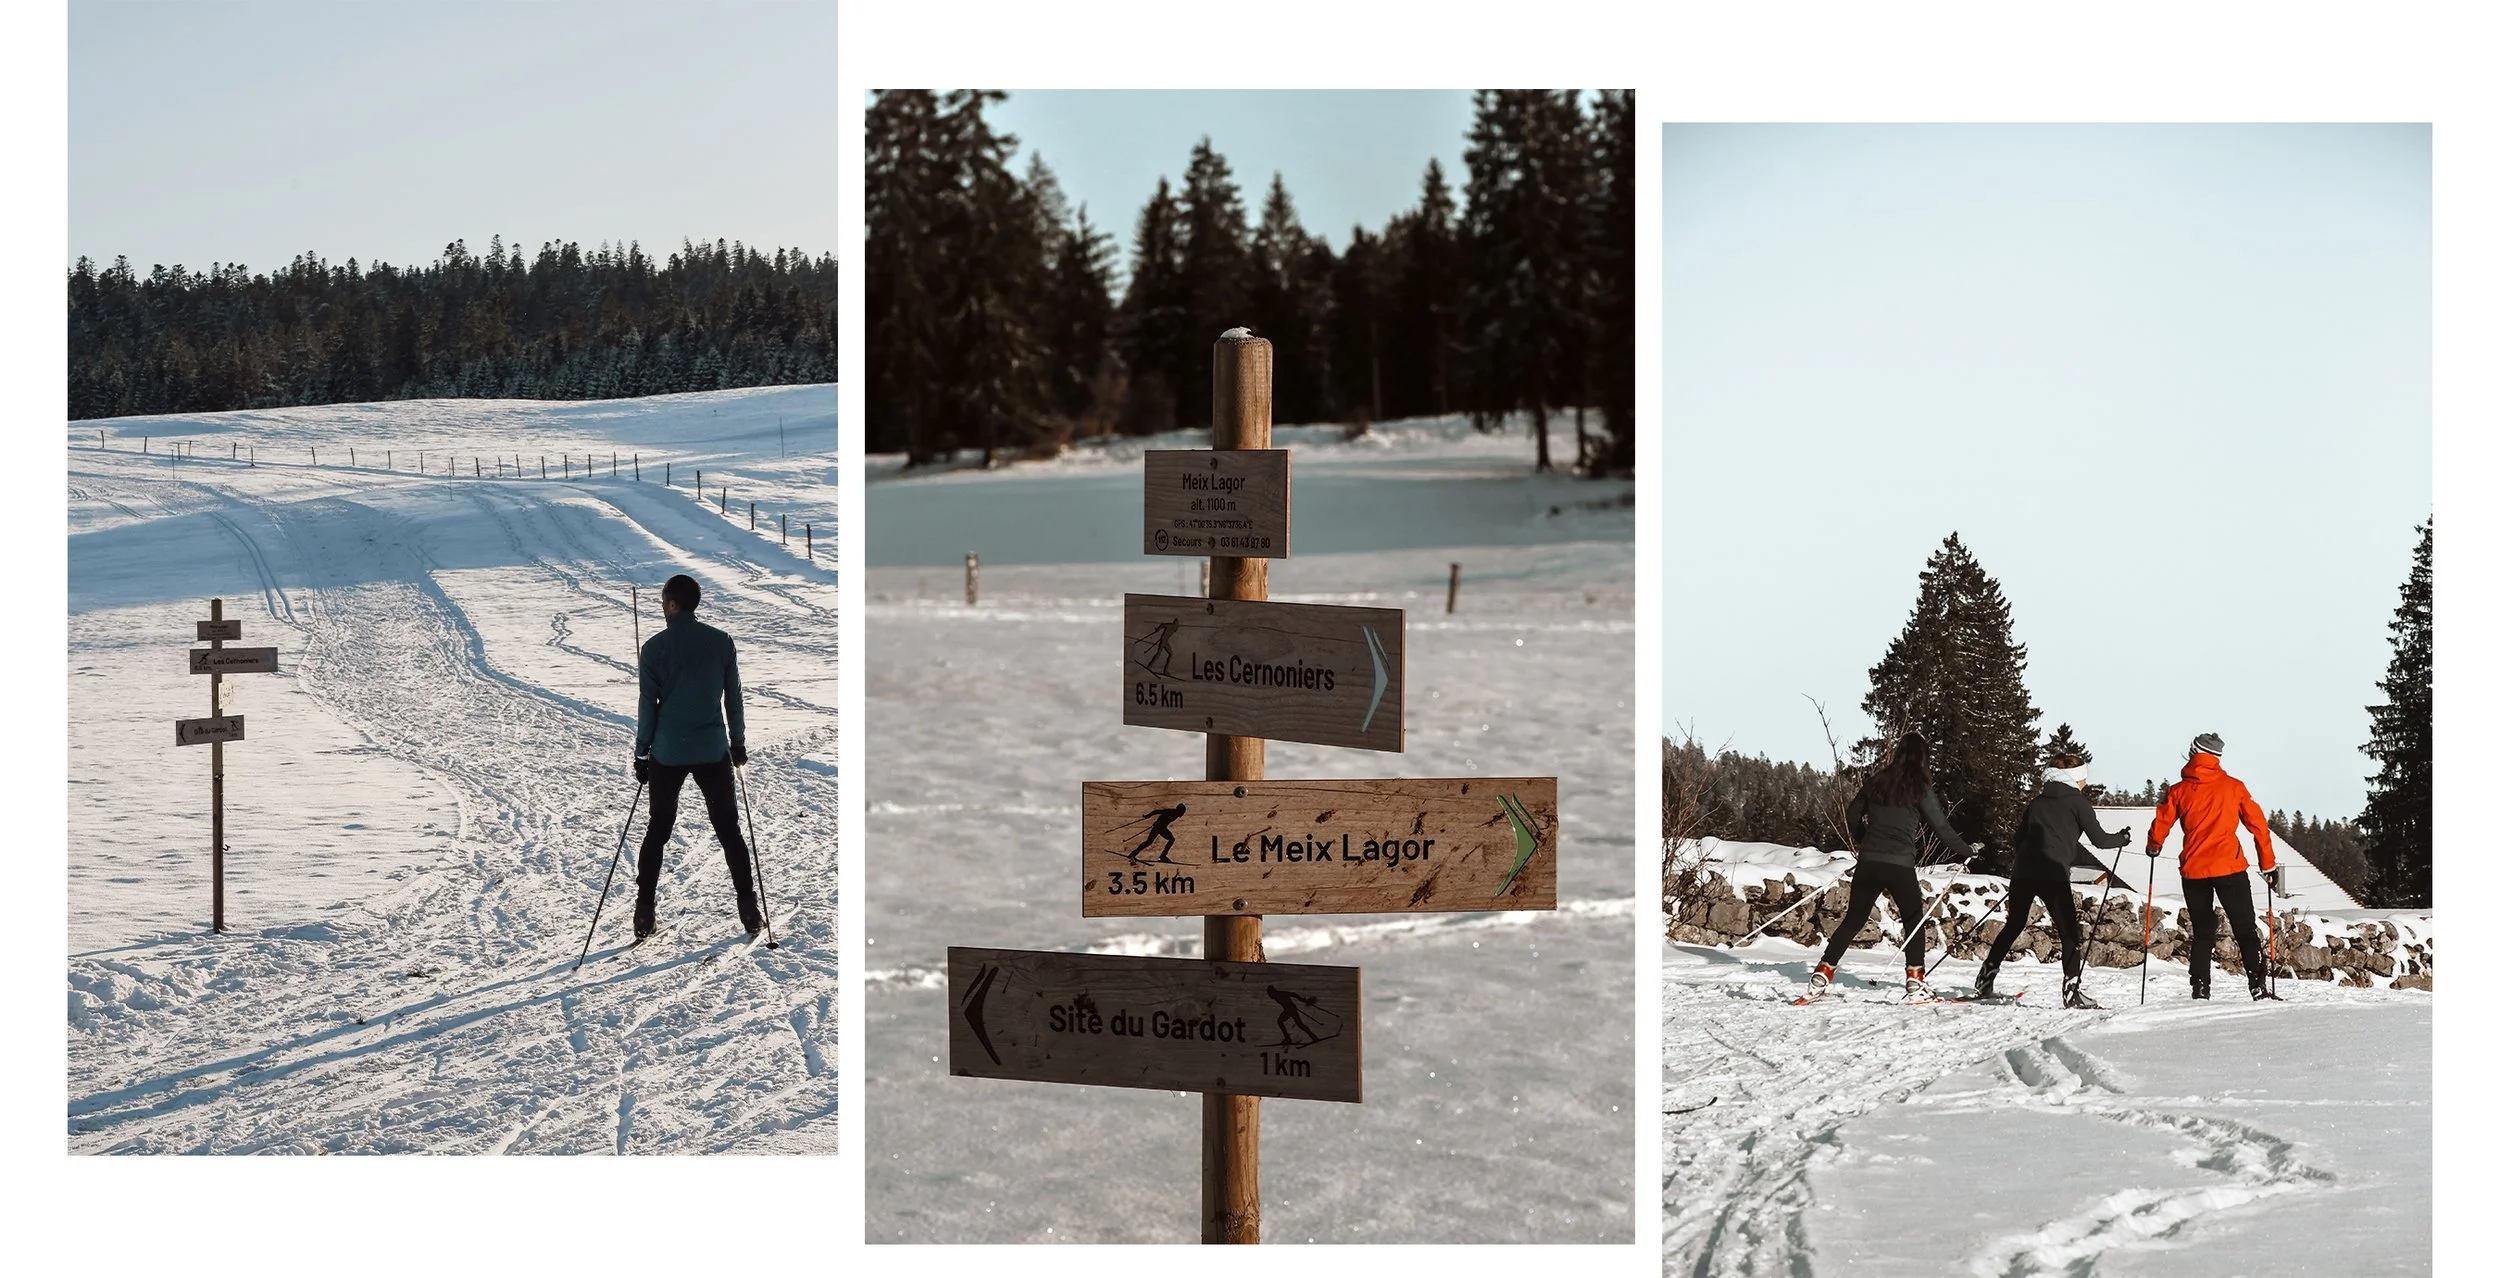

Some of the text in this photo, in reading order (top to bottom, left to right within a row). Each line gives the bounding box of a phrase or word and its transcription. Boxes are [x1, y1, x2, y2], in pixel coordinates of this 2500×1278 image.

[1182, 473, 1245, 494] Meix Lagor
[1191, 498, 1236, 511] alt. 1100 m
[1172, 535, 1202, 547] Secours
[1192, 652, 1335, 691] Les Cernoniers
[1135, 682, 1184, 709] 6.5 km
[1211, 834, 1435, 867] Le Meix Lagor
[1108, 872, 1195, 895] 3.5 km
[1050, 1002, 1246, 1043] Site du Gardot
[1259, 1052, 1311, 1078] 1 km
